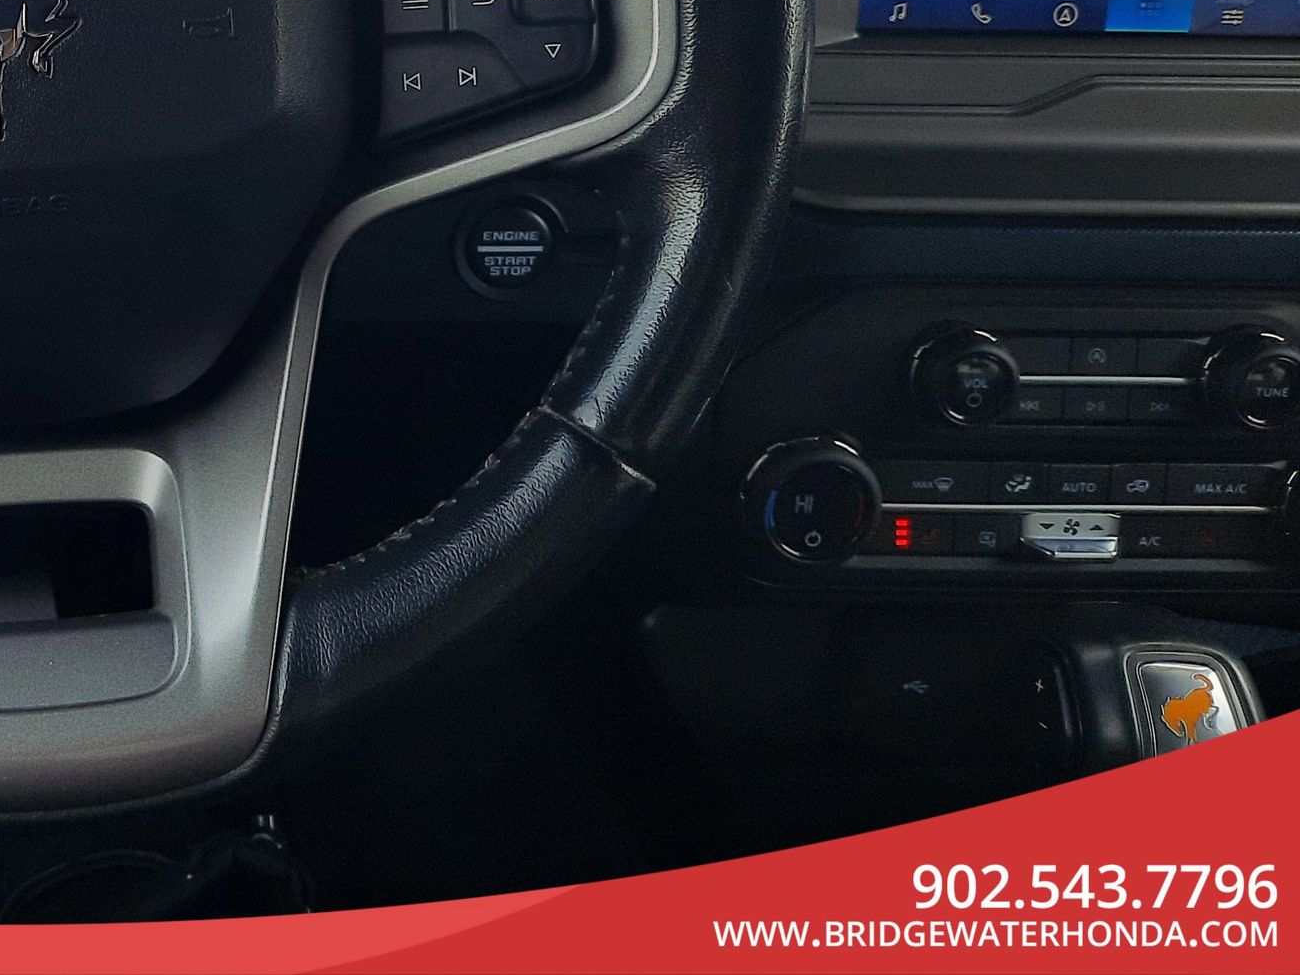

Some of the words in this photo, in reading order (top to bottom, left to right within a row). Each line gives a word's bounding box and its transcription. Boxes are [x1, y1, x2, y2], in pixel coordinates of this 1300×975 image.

[482, 230, 540, 241] ENGINE
[484, 255, 537, 266] START
[490, 266, 532, 276] STOP
[1256, 387, 1289, 398] TUNE
[1062, 481, 1097, 493] AUTO
[1193, 482, 1222, 494] MAX
[1225, 482, 1249, 495] A/C
[1138, 536, 1162, 548] A/C
